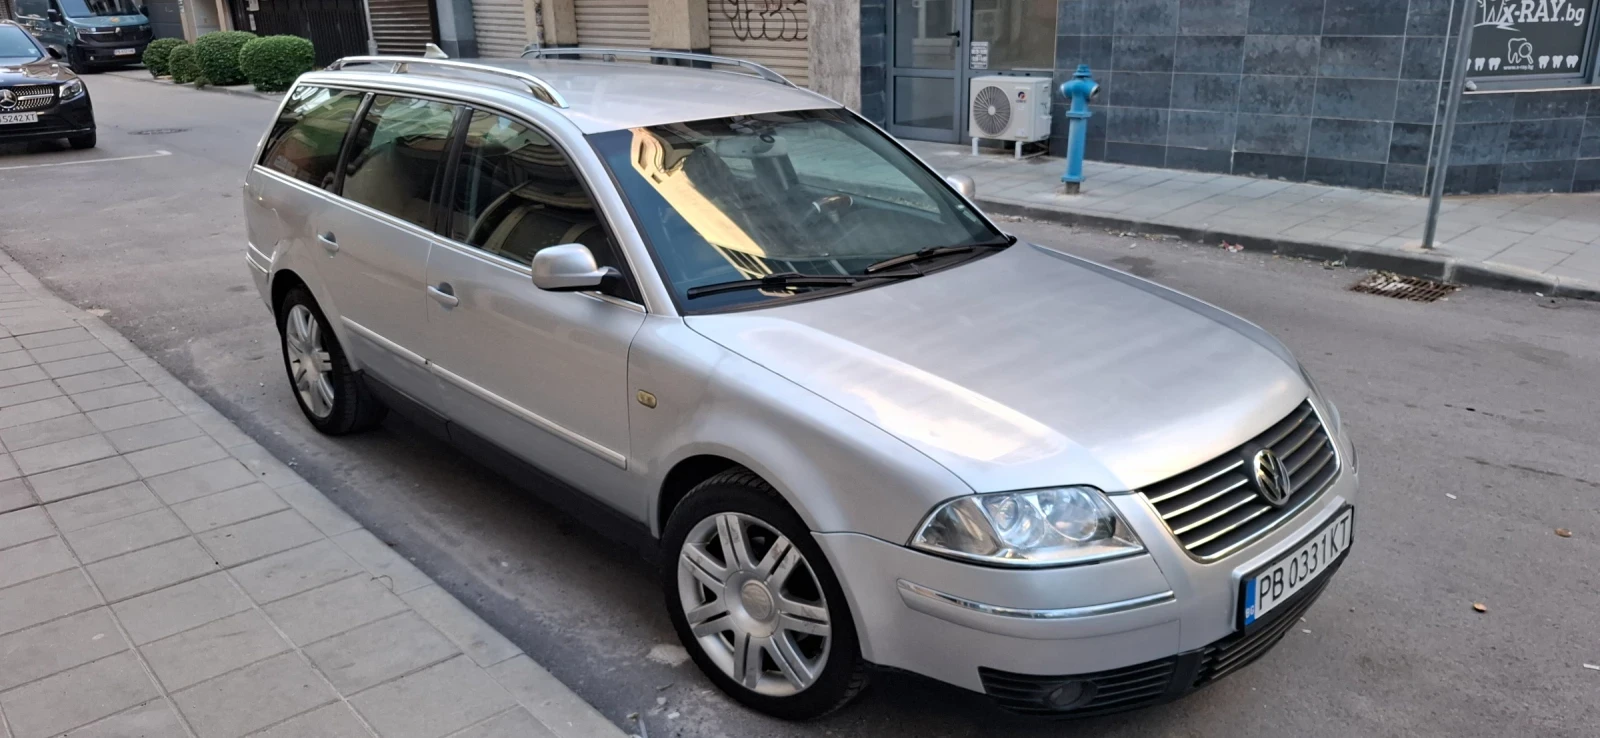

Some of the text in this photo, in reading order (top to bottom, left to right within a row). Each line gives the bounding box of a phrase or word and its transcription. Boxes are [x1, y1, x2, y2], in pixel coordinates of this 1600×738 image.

[2, 114, 23, 123] 5242
[25, 113, 35, 121] XT
[1259, 515, 1349, 611] PB 0331 KT
[1245, 605, 1255, 618] BG
